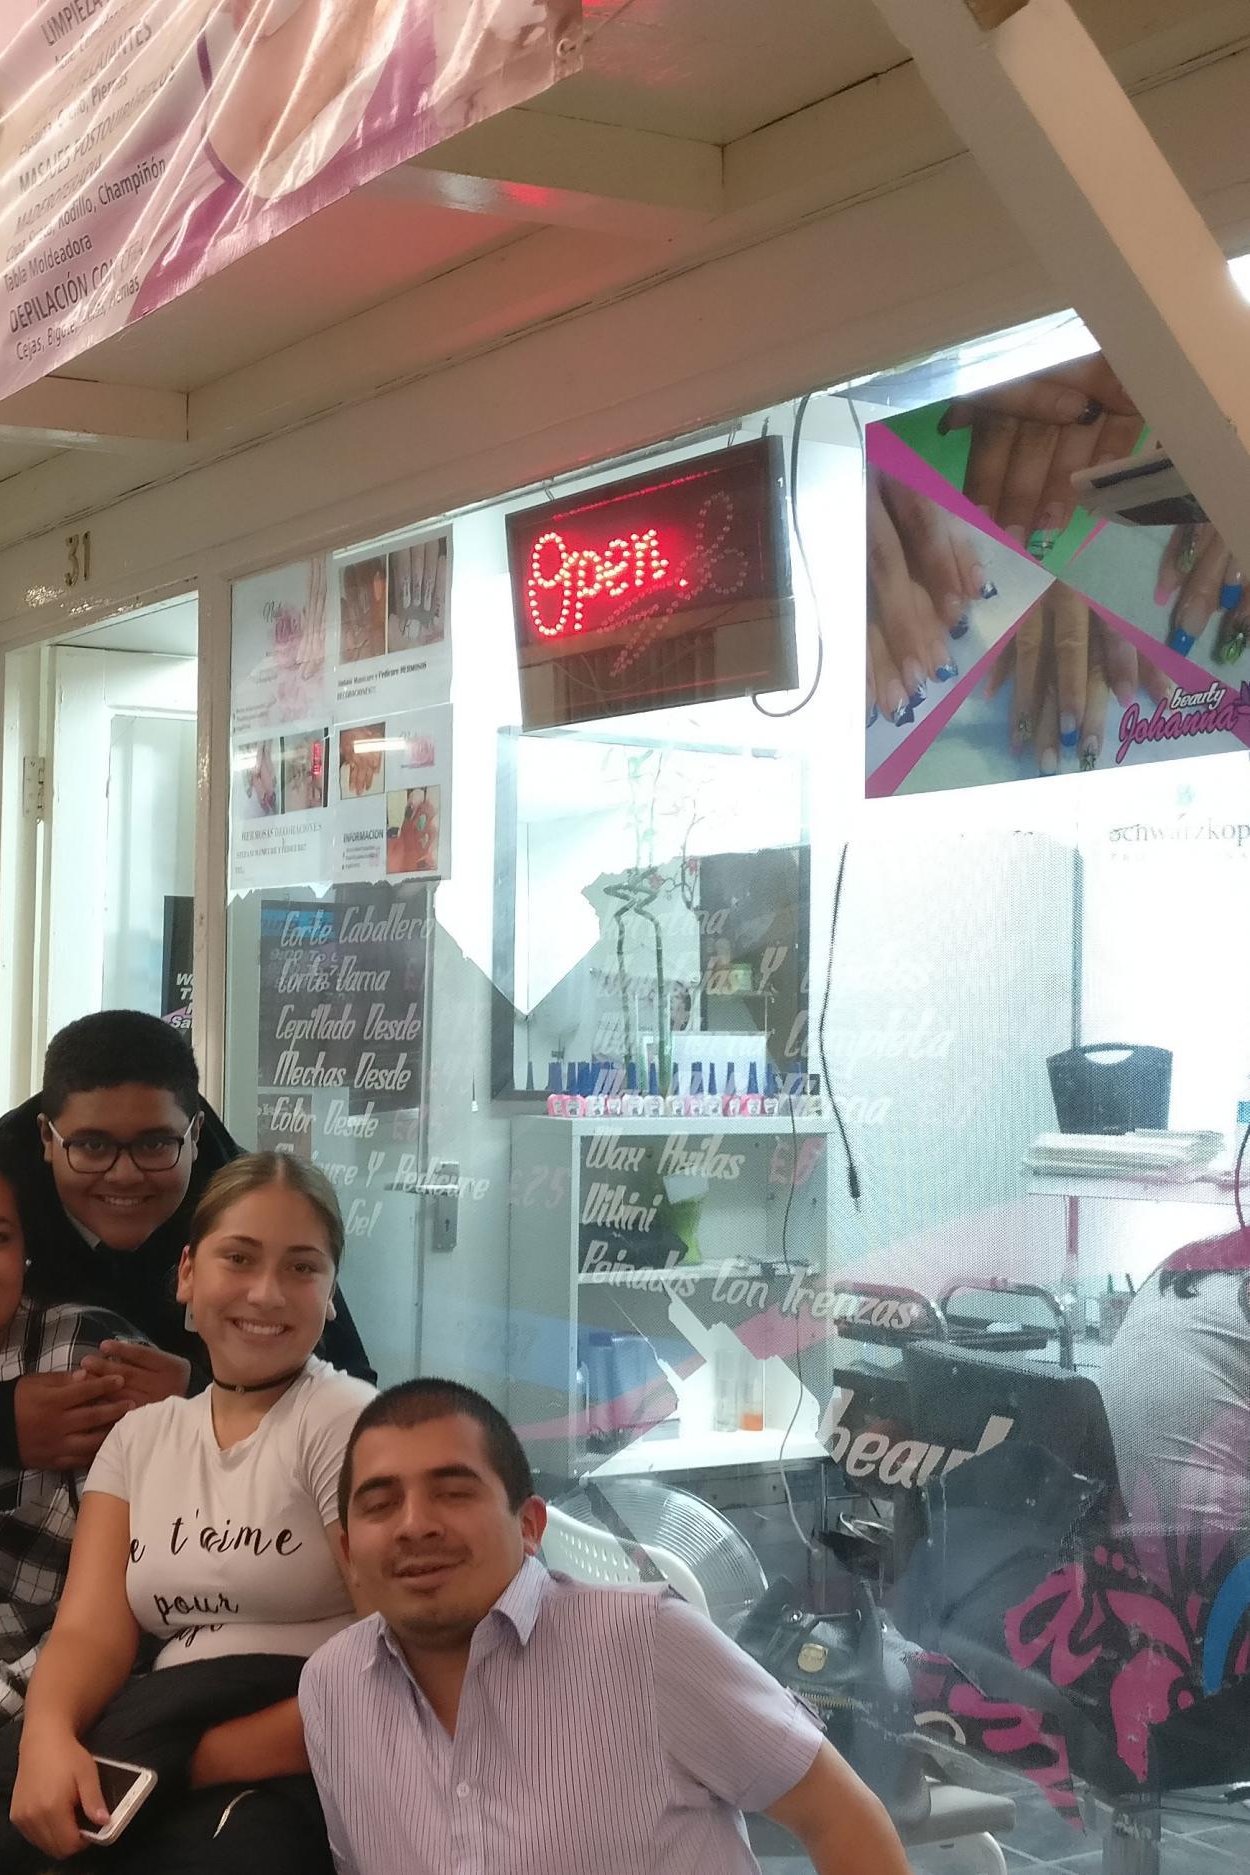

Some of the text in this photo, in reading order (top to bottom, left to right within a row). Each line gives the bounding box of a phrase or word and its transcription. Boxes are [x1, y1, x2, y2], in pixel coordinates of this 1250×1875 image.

[98, 156, 166, 206] Champiñón
[29, 234, 93, 277] Moldeadora
[9, 271, 88, 334] DEPILACIÓN
[528, 530, 669, 635] Open
[1170, 677, 1227, 710] beauty
[1115, 697, 1239, 765] Johanna
[280, 908, 333, 948] Corte
[339, 902, 436, 945] Caballero
[278, 955, 391, 994] Corte Dama
[275, 1002, 421, 1051] Cepillado Desde
[272, 1049, 412, 1091] Mechas Desde
[270, 1096, 316, 1134] Color
[323, 1100, 379, 1138] Desde
[585, 1127, 646, 1173] Wax
[579, 1239, 700, 1298] Peinados
[711, 1258, 769, 1308] Con
[816, 1385, 1015, 1489] beau
[170, 1508, 303, 1556] t'aime
[154, 1593, 239, 1625] pour
